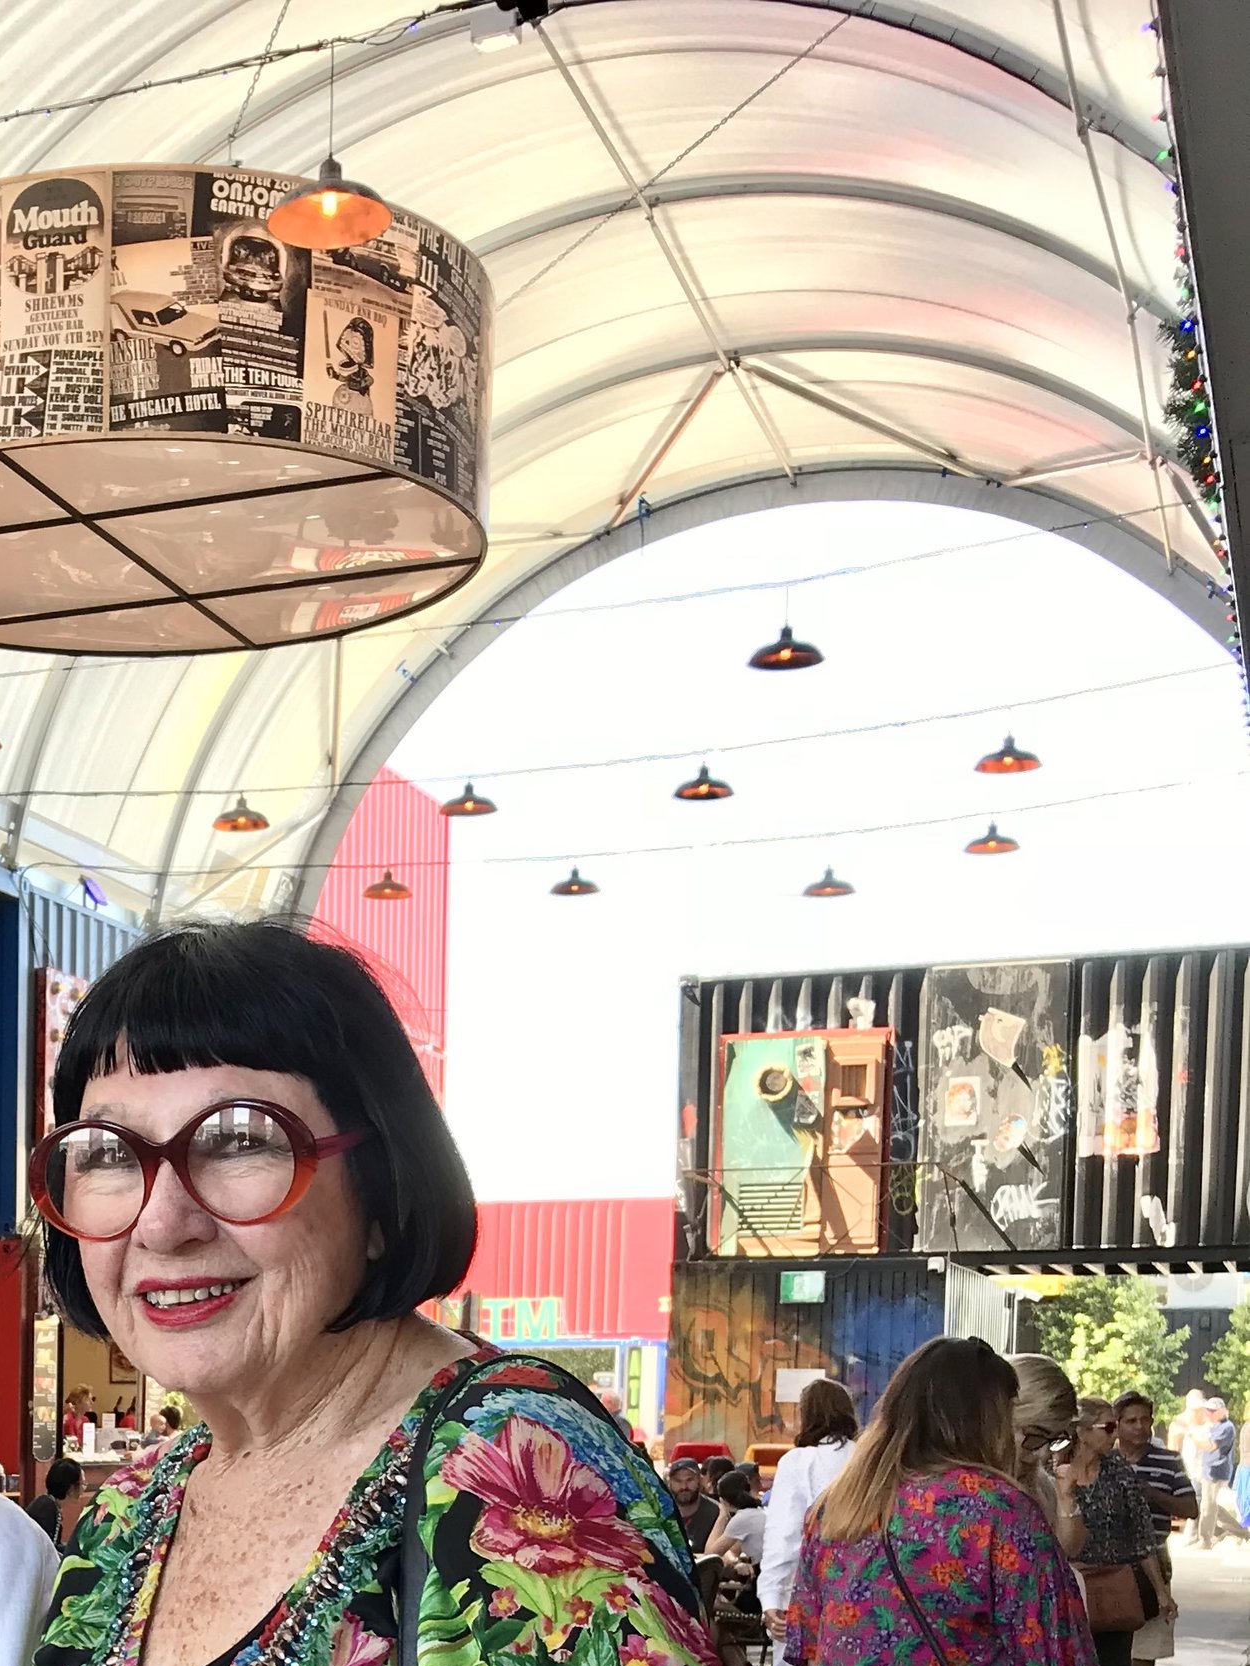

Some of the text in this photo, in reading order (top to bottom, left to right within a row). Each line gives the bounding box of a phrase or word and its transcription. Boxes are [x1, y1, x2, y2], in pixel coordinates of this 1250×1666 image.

[12, 200, 100, 234] Mouth
[210, 198, 255, 217] EARTH
[21, 229, 87, 251] Guard
[191, 241, 214, 251] LIVE
[30, 309, 78, 322] GENTLEMEN
[25, 319, 84, 335] MUSTANG BAR
[3, 337, 40, 352] SUNDAY
[42, 333, 61, 346] NOV
[65, 331, 83, 344] 4TH
[110, 338, 157, 363] INSIDE
[189, 357, 223, 374] FRIDAY
[223, 366, 246, 384] THE
[248, 368, 271, 387] TEN
[128, 397, 183, 419] TINGALPA
[185, 393, 221, 412] HOTEL
[304, 417, 327, 433] THE
[331, 422, 365, 443] MERCY
[368, 432, 392, 453] BEAT
